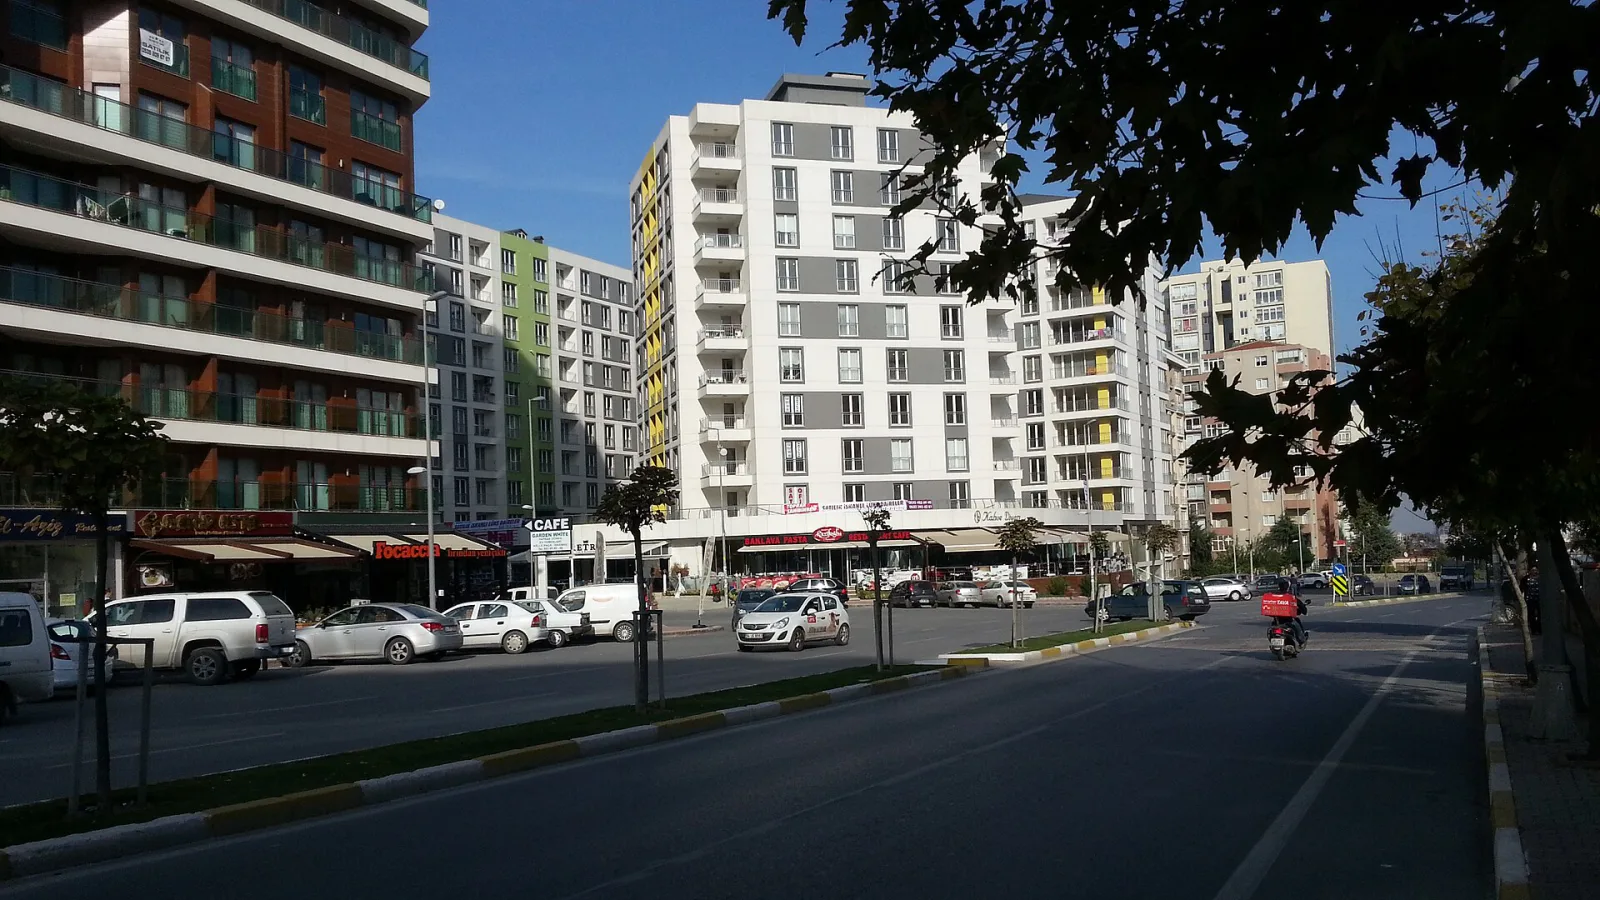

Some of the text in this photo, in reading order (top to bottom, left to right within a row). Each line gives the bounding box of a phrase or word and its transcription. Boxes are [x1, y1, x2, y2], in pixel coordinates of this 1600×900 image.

[534, 518, 570, 531] CAFE
[744, 537, 780, 546] BAKLAVA
[783, 535, 808, 544] PASTA
[893, 530, 910, 540] CAFE
[375, 541, 440, 560] Focacca
